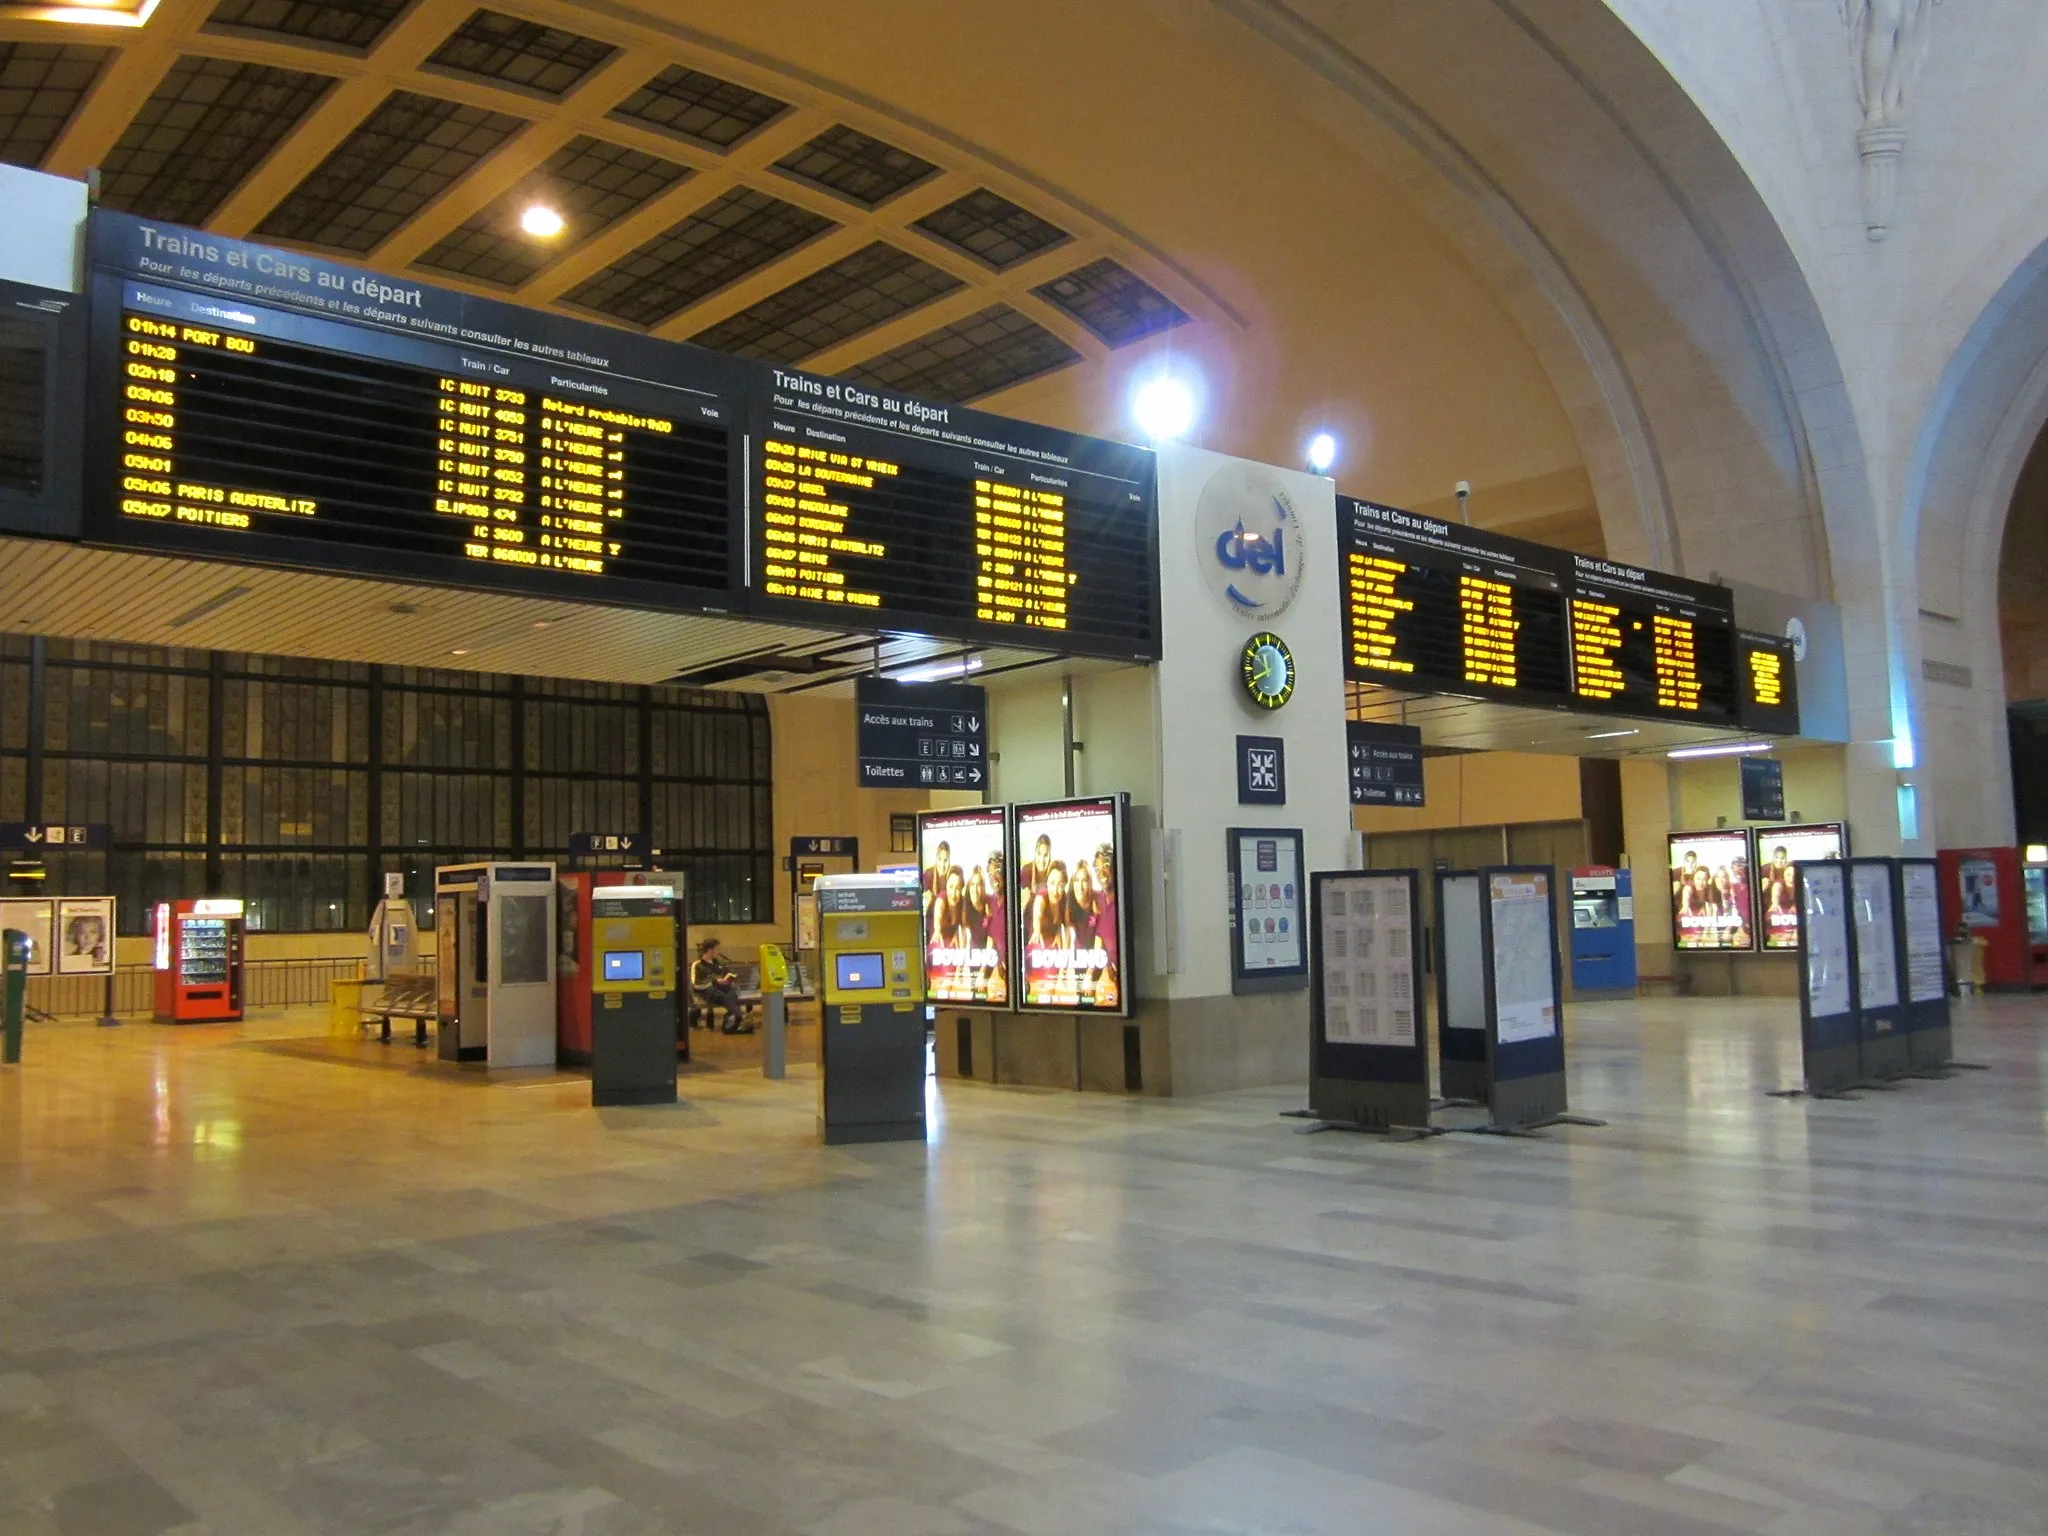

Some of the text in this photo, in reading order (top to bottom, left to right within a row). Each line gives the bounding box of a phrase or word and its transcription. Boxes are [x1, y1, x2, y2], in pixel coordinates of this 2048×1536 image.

[139, 226, 423, 308] Trains et Cars au départ
[137, 291, 256, 326] Heure Destination
[180, 266, 199, 281] les
[203, 271, 252, 292] départs
[255, 283, 326, 309] précédents
[328, 298, 341, 309] et
[343, 300, 360, 314] les
[363, 304, 408, 326] départs
[411, 314, 458, 336] suivants
[460, 328, 513, 347] consulter
[514, 337, 530, 351] les
[532, 343, 565, 358] autres
[567, 347, 610, 368] tableaux
[129, 318, 255, 353] 01h14 PORT BOU
[128, 341, 177, 361] 01h28
[127, 363, 176, 383] 02h18
[461, 357, 487, 372] Train
[493, 362, 510, 376] Car
[440, 378, 455, 392] IC
[459, 383, 491, 398] NUIT
[551, 376, 608, 396] Particularités
[773, 370, 949, 424] Trains et Cars au départ
[440, 398, 455, 412] IC
[459, 403, 491, 418] NUIT
[543, 398, 585, 417] Retard
[701, 406, 719, 419] Voie
[126, 409, 174, 428] 03h50
[439, 418, 455, 432] IC
[459, 422, 491, 437] NUIT
[541, 417, 604, 440] A L'HEURE
[773, 394, 1069, 465] Pour les départs précédents et les départs suivants consulter les autres tableaux
[773, 421, 846, 443] Heure Destination
[439, 438, 455, 452] IC
[459, 443, 490, 458] NUIT
[541, 437, 604, 459] A L'HEURE
[124, 454, 172, 473] 05h01
[439, 459, 455, 473] IC
[458, 463, 490, 478] NUIT
[541, 456, 604, 478] A L'HEURE
[830, 453, 848, 466] VIA
[851, 457, 864, 468] ST
[974, 462, 1005, 476] Train Car
[798, 465, 812, 477] LA
[438, 480, 454, 493] IC
[458, 483, 490, 498] NUIT
[541, 476, 604, 497] A L'HEURE
[178, 484, 225, 502] PARIS
[230, 491, 316, 515] AUSTERLITZ
[541, 496, 604, 516] A L'HEURE
[122, 500, 250, 528] 05h07 POITIERS
[1354, 502, 1448, 536] Trains et Cars au départ
[474, 525, 489, 538] IC
[541, 515, 604, 535] A L'HEURE
[464, 544, 490, 558] TER
[541, 535, 604, 554] A L'HEURE
[799, 534, 885, 557] PARIS AUSTERLITZ
[541, 554, 604, 573] A L'HEURE
[799, 552, 829, 566] BRIVE
[1574, 556, 1594, 570] Trains
[1595, 562, 1601, 571] et
[1603, 562, 1617, 575] Cars
[1618, 568, 1625, 577] au
[1626, 569, 1645, 581] départ
[800, 569, 845, 585] POITIERS
[864, 713, 934, 728] Accès aux trains
[923, 745, 929, 754] E
[864, 765, 905, 777] Toilettes
[1681, 915, 1743, 928] BOWLING
[932, 948, 998, 968] BOWLING
[1031, 948, 1108, 969] BOWLING
